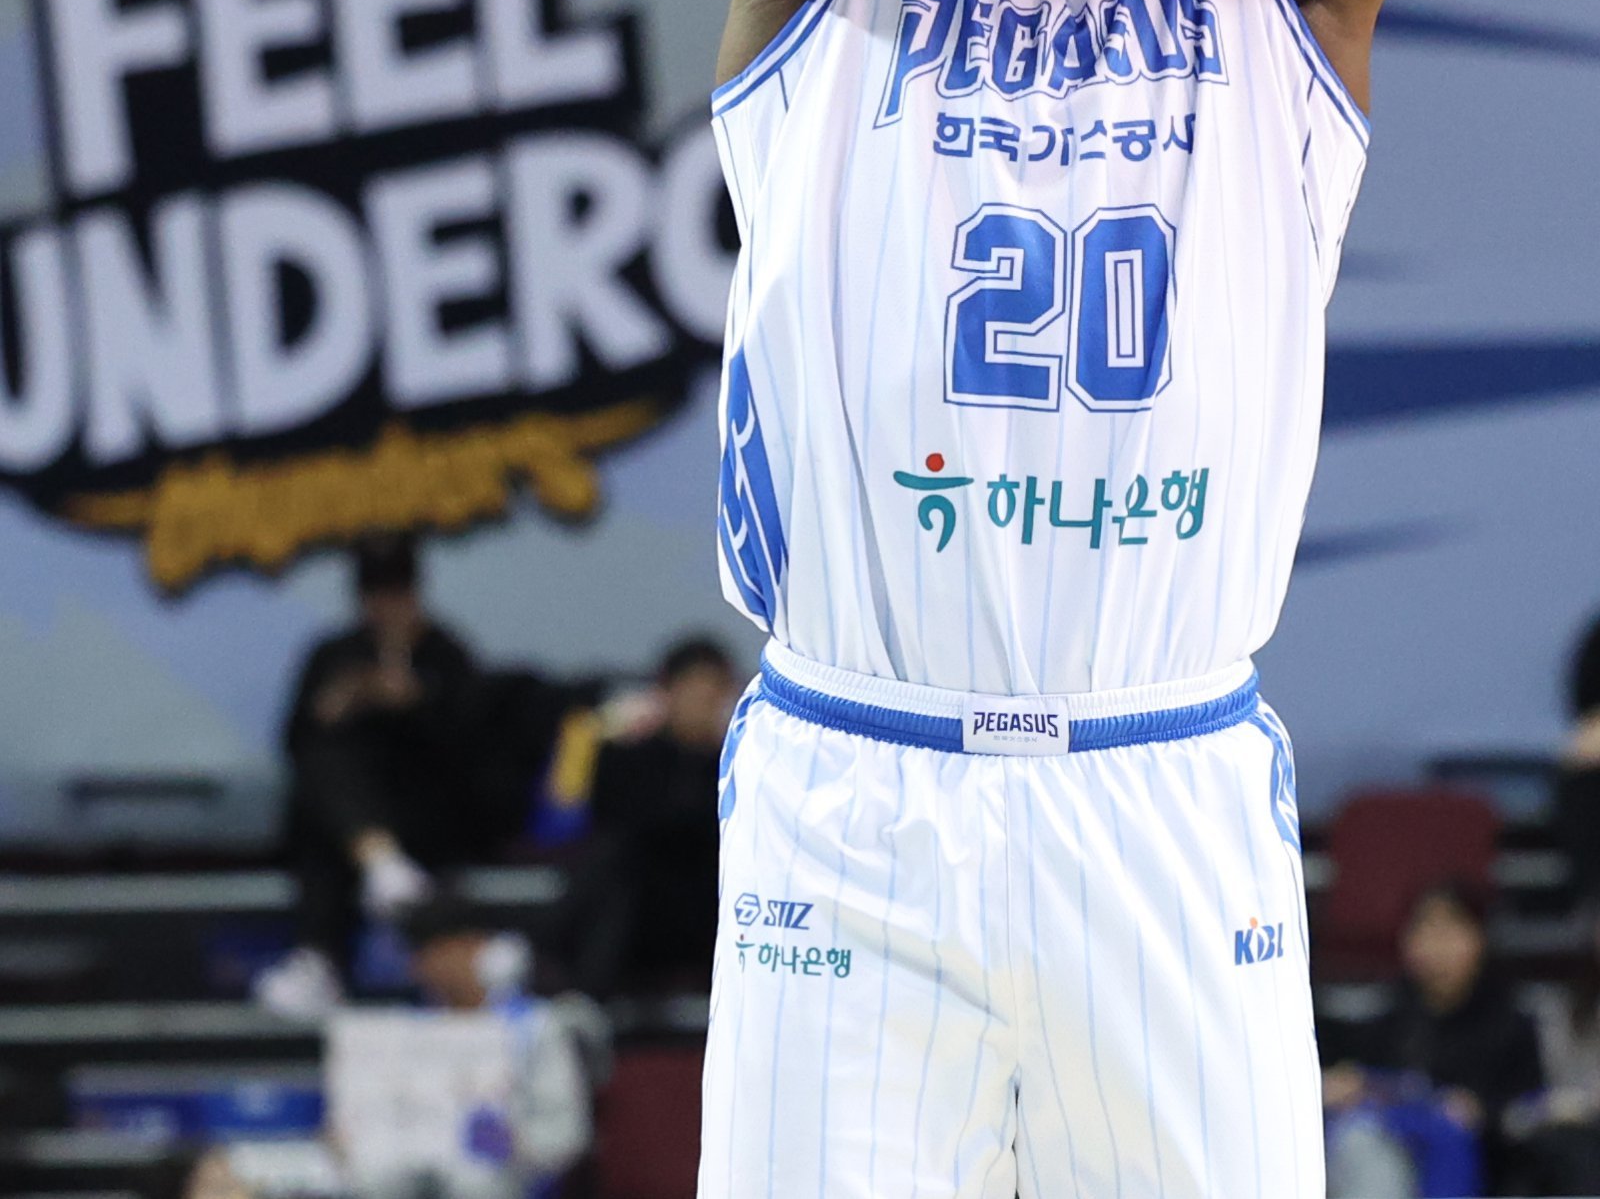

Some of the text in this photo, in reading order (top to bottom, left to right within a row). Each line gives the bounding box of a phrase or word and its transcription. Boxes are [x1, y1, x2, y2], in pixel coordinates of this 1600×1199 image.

[933, 112, 1196, 166] 한국가스공사
[943, 202, 1178, 413] 20
[986, 468, 1210, 550] 하나은행
[973, 711, 1059, 739] PEGASUS
[763, 899, 815, 931] STIZ
[758, 942, 852, 979] 하나은행
